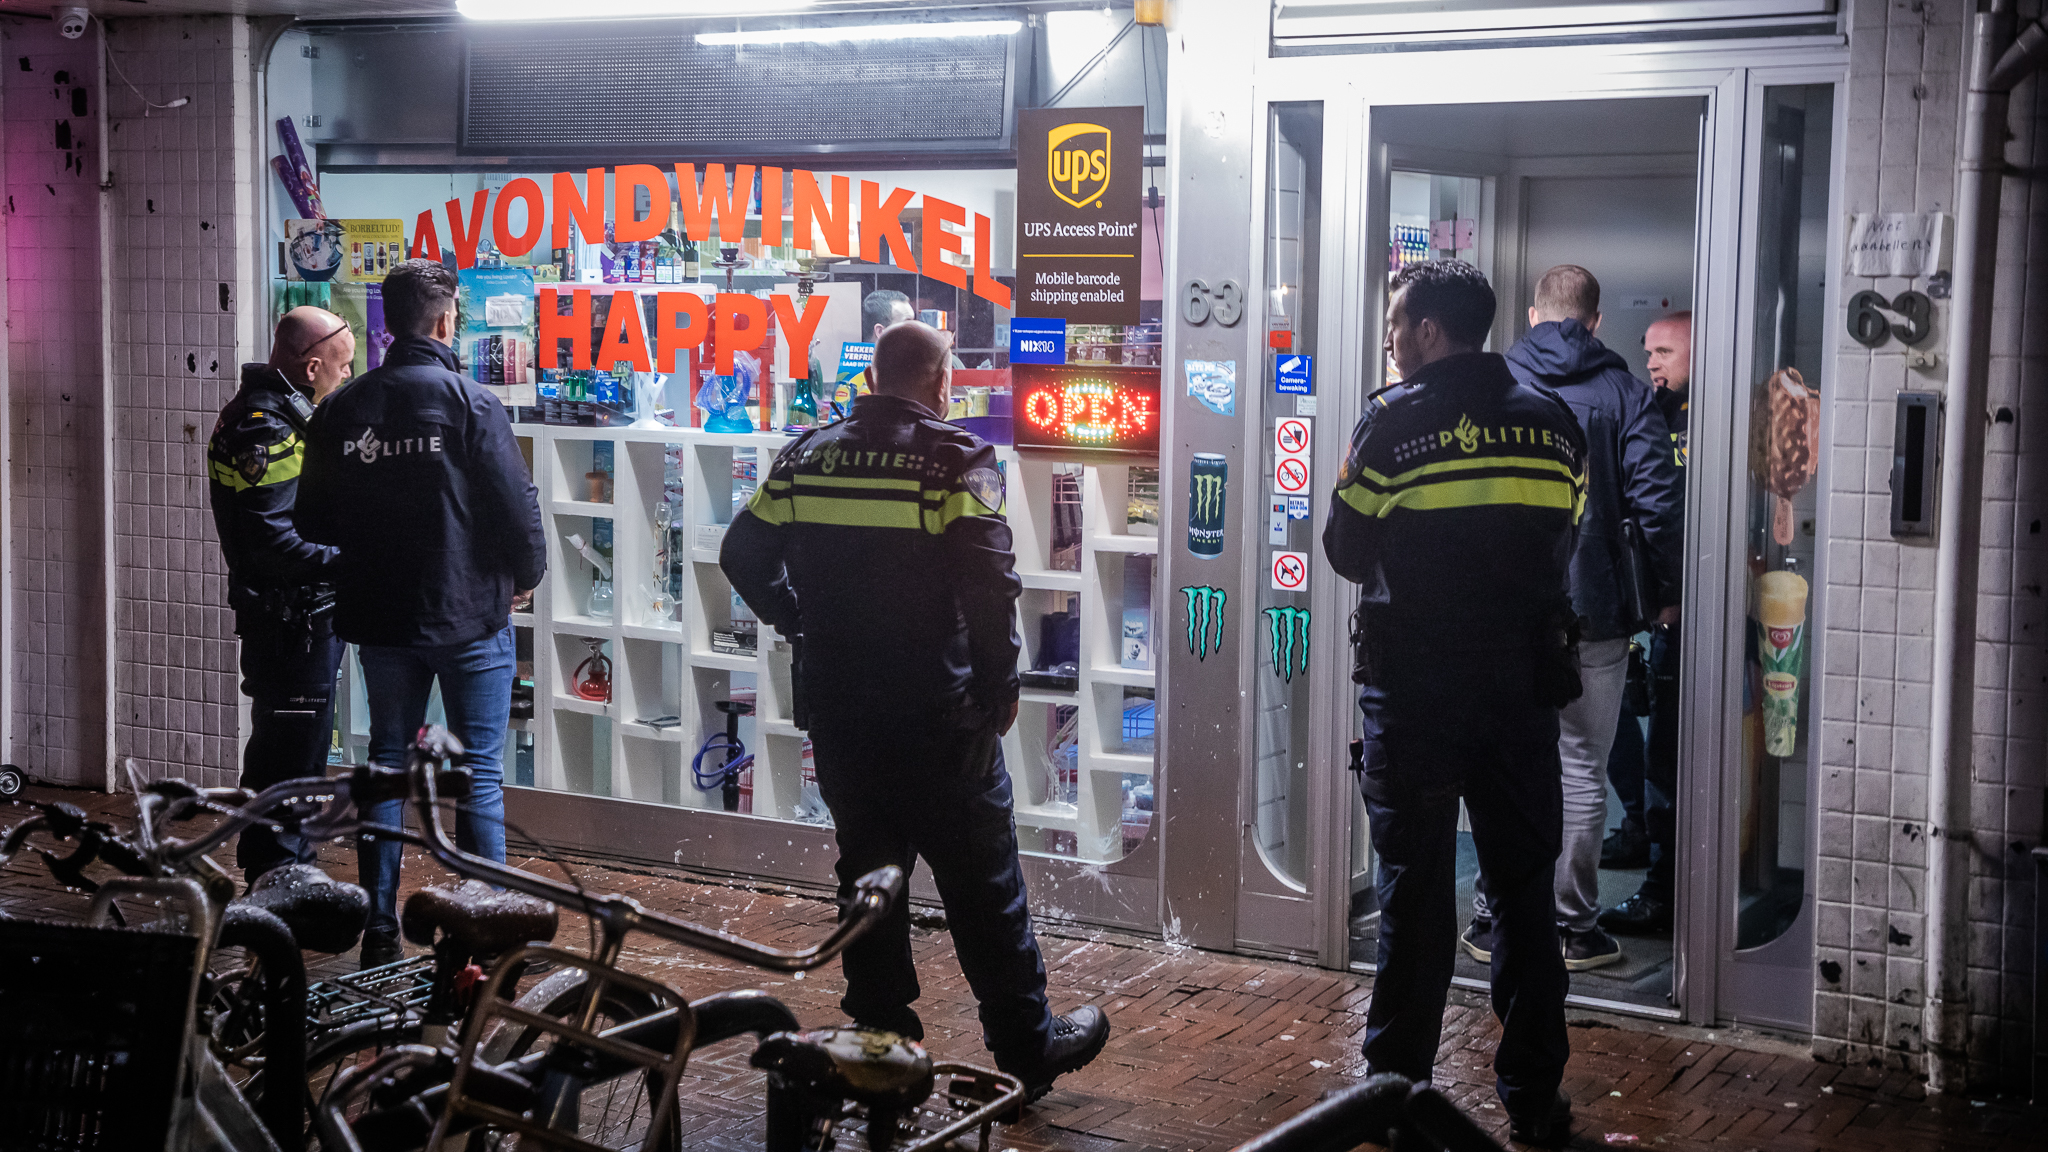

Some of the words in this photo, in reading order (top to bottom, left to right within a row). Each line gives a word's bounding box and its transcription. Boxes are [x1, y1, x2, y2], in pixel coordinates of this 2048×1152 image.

[410, 163, 1012, 310] AVONDWINKEL
[1024, 222, 1051, 238] UPS
[1053, 222, 1096, 238] Access
[1035, 272, 1074, 285] Mobile
[1076, 272, 1120, 285] barcode
[1030, 289, 1078, 305] shipping
[1080, 289, 1124, 303] enabled
[1181, 278, 1243, 327] 63
[1846, 289, 1931, 345] 63
[539, 288, 830, 380] HAPPY
[845, 345, 875, 354] LEKKER
[1279, 384, 1308, 393] bewaking
[1026, 390, 1151, 431] OPEN
[1189, 525, 1224, 539] MONSTER
